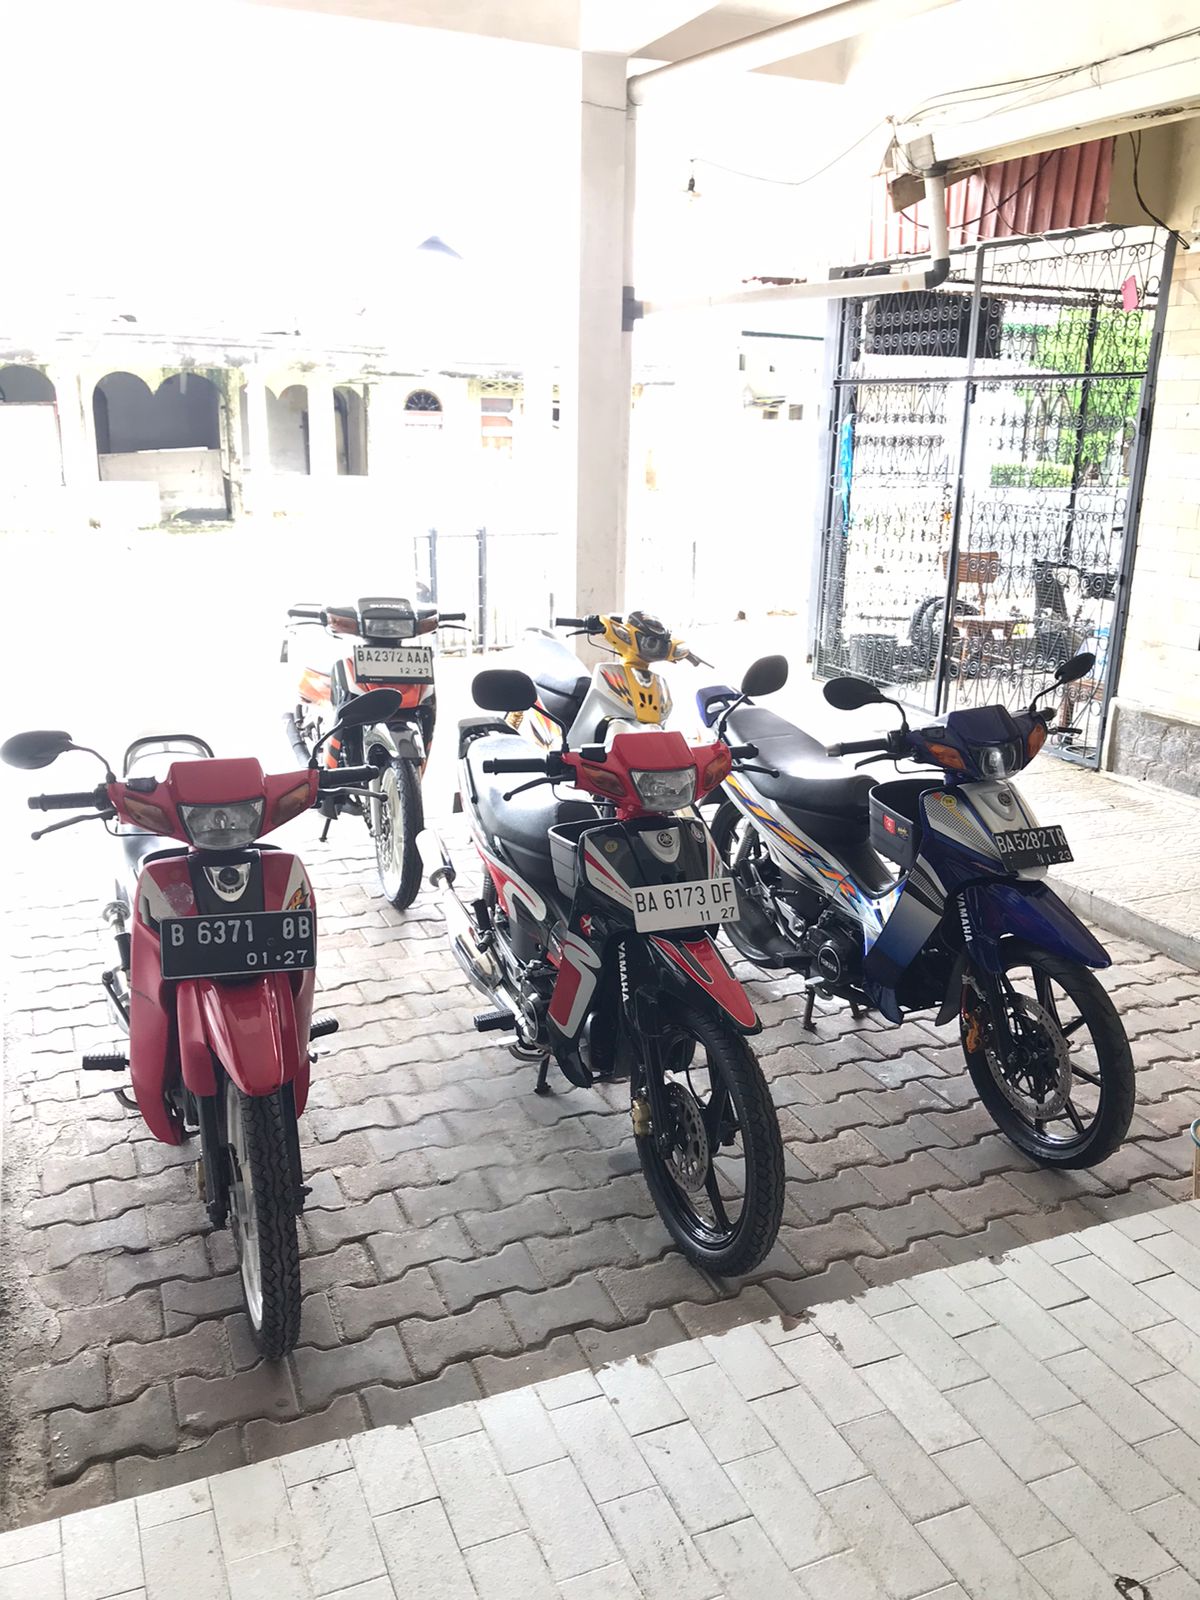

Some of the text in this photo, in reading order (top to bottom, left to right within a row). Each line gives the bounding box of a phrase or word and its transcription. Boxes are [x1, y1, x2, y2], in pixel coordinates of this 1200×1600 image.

[407, 651, 429, 664] AAA
[635, 882, 733, 913] BA 6173 DF
[700, 906, 735, 921] 11 27
[957, 893, 973, 942] YAMAHA
[170, 923, 185, 947] B
[197, 919, 254, 945] 6371
[617, 941, 631, 1003] YAMAHA
